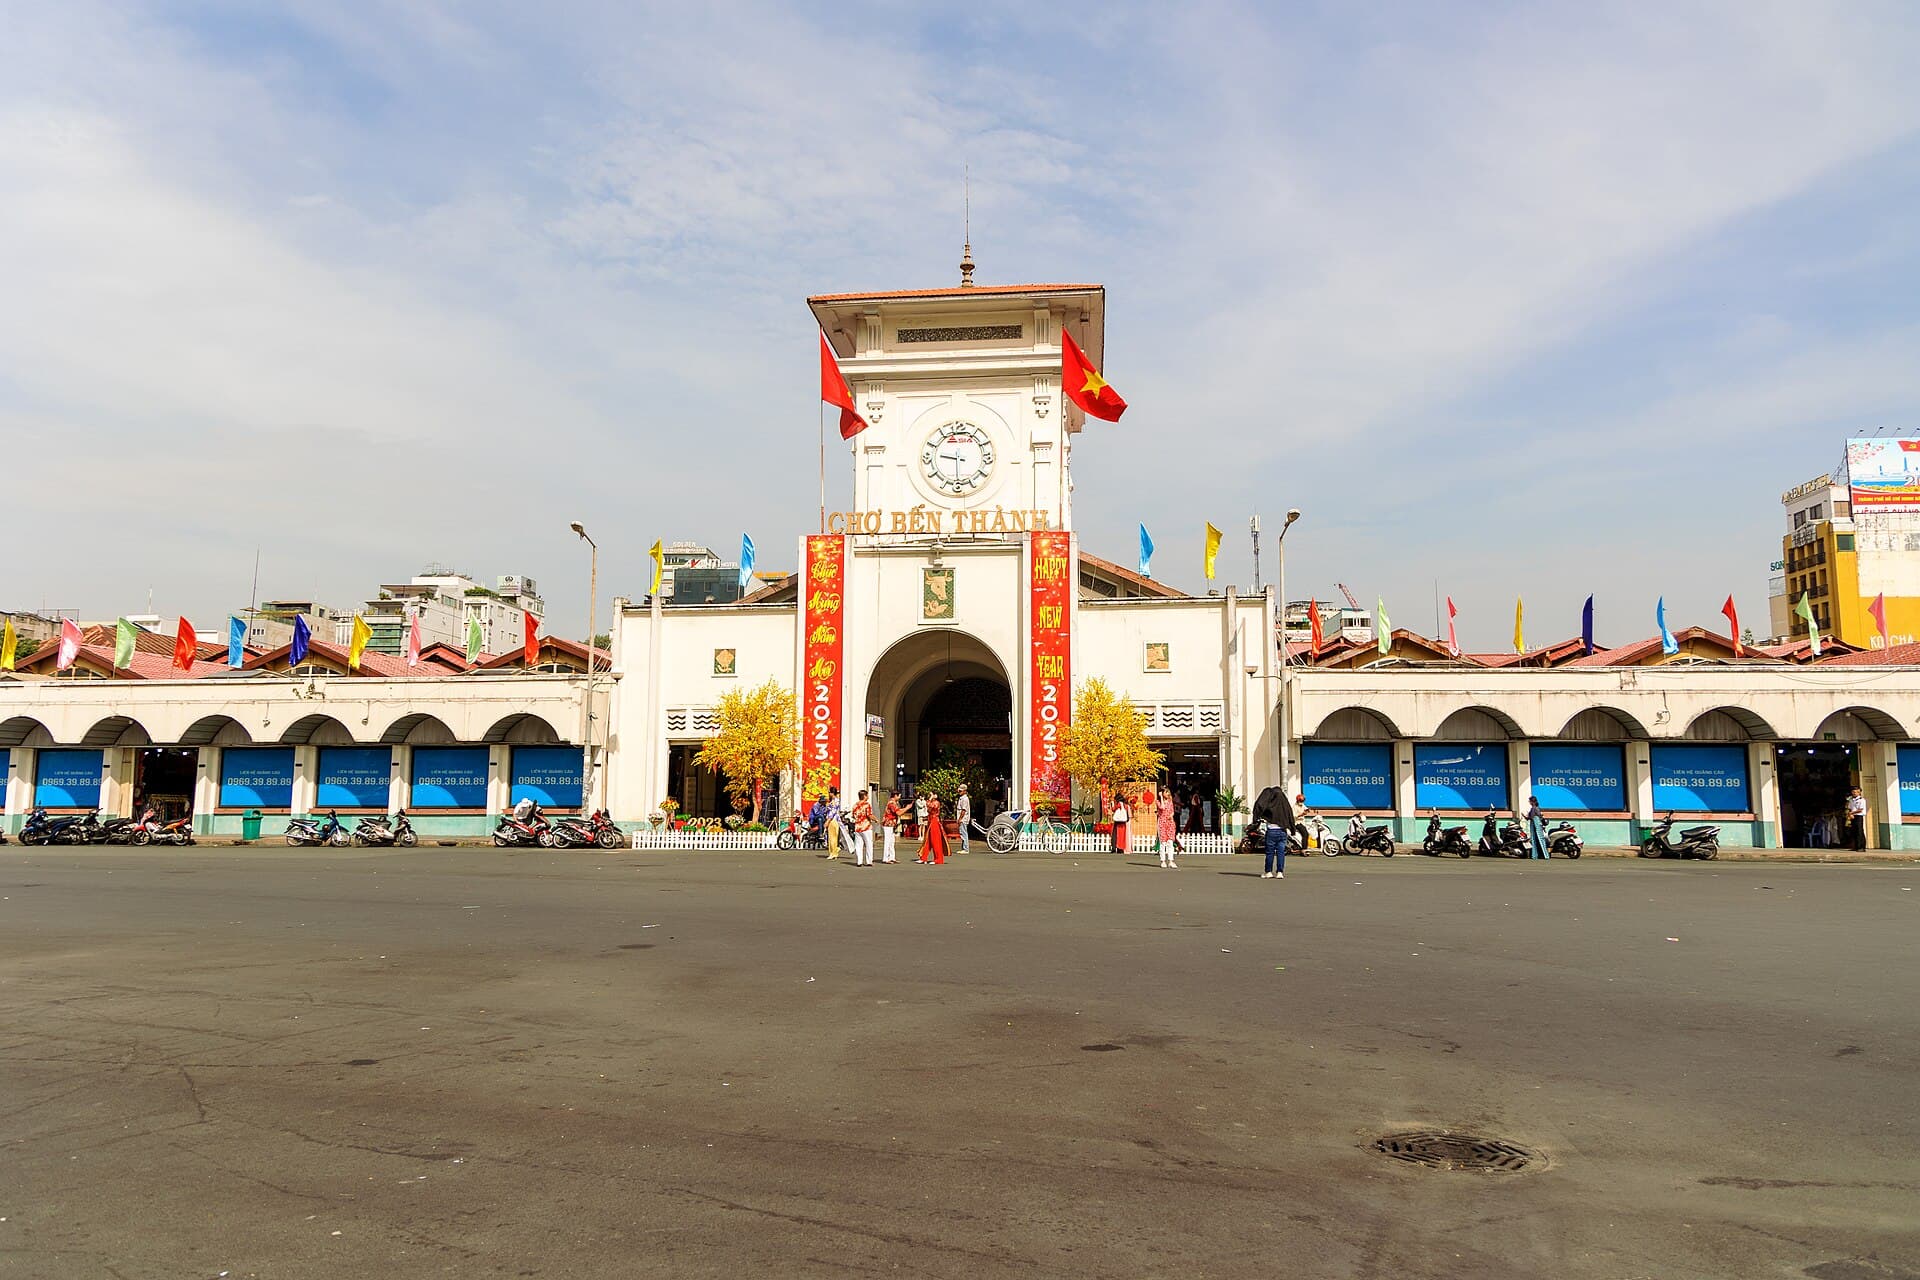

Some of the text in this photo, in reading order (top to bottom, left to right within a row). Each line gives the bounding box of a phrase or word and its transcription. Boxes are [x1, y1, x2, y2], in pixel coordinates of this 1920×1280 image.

[828, 504, 1049, 537] CHỢ BẾN THÀNH
[811, 560, 838, 582] Chúc
[1035, 557, 1067, 580] HAPPY
[1039, 606, 1062, 629] NEW
[1037, 655, 1065, 680] YEAR
[813, 685, 831, 760] 2023
[1041, 684, 1059, 762] 2023
[227, 777, 292, 786] 0969.39.89.89
[325, 776, 390, 785] 0969.39.89.89
[418, 777, 485, 786] 0969.39.89.89
[1309, 775, 1385, 785] 0969.39.89.89
[1423, 776, 1501, 786] 0969.39.89.89
[1538, 777, 1617, 787] 0969.39.89.89
[1659, 777, 1741, 788] 0969.39.89.89
[687, 817, 722, 830] 2023
